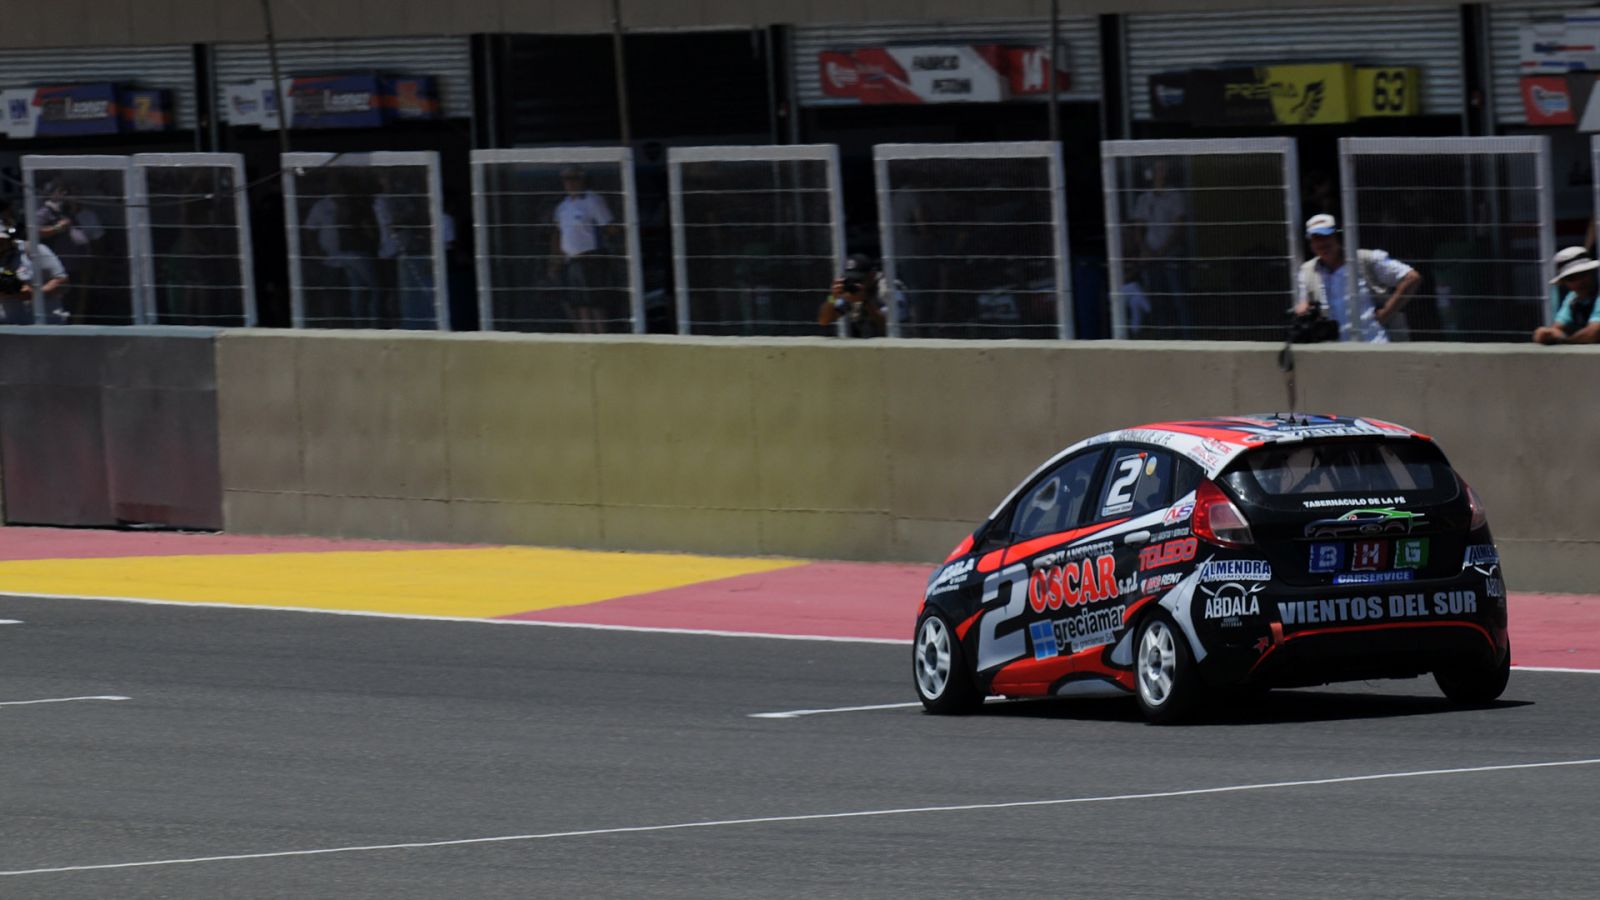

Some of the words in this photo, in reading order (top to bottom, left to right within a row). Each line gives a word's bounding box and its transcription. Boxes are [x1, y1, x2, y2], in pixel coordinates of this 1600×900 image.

[1374, 71, 1406, 111] 63
[1105, 458, 1143, 507] 2
[1368, 497, 1380, 505] DE
[1138, 537, 1198, 572] TOLEDO
[1199, 560, 1271, 578] ALMENDRA
[1029, 554, 1119, 614] OSCAR
[976, 563, 1028, 672] 2
[1205, 594, 1260, 620] ABDALA
[1277, 596, 1385, 625] VIENTOS
[1388, 593, 1430, 618] DEL
[1433, 590, 1477, 616] SUR
[1053, 605, 1126, 651] greciamar
